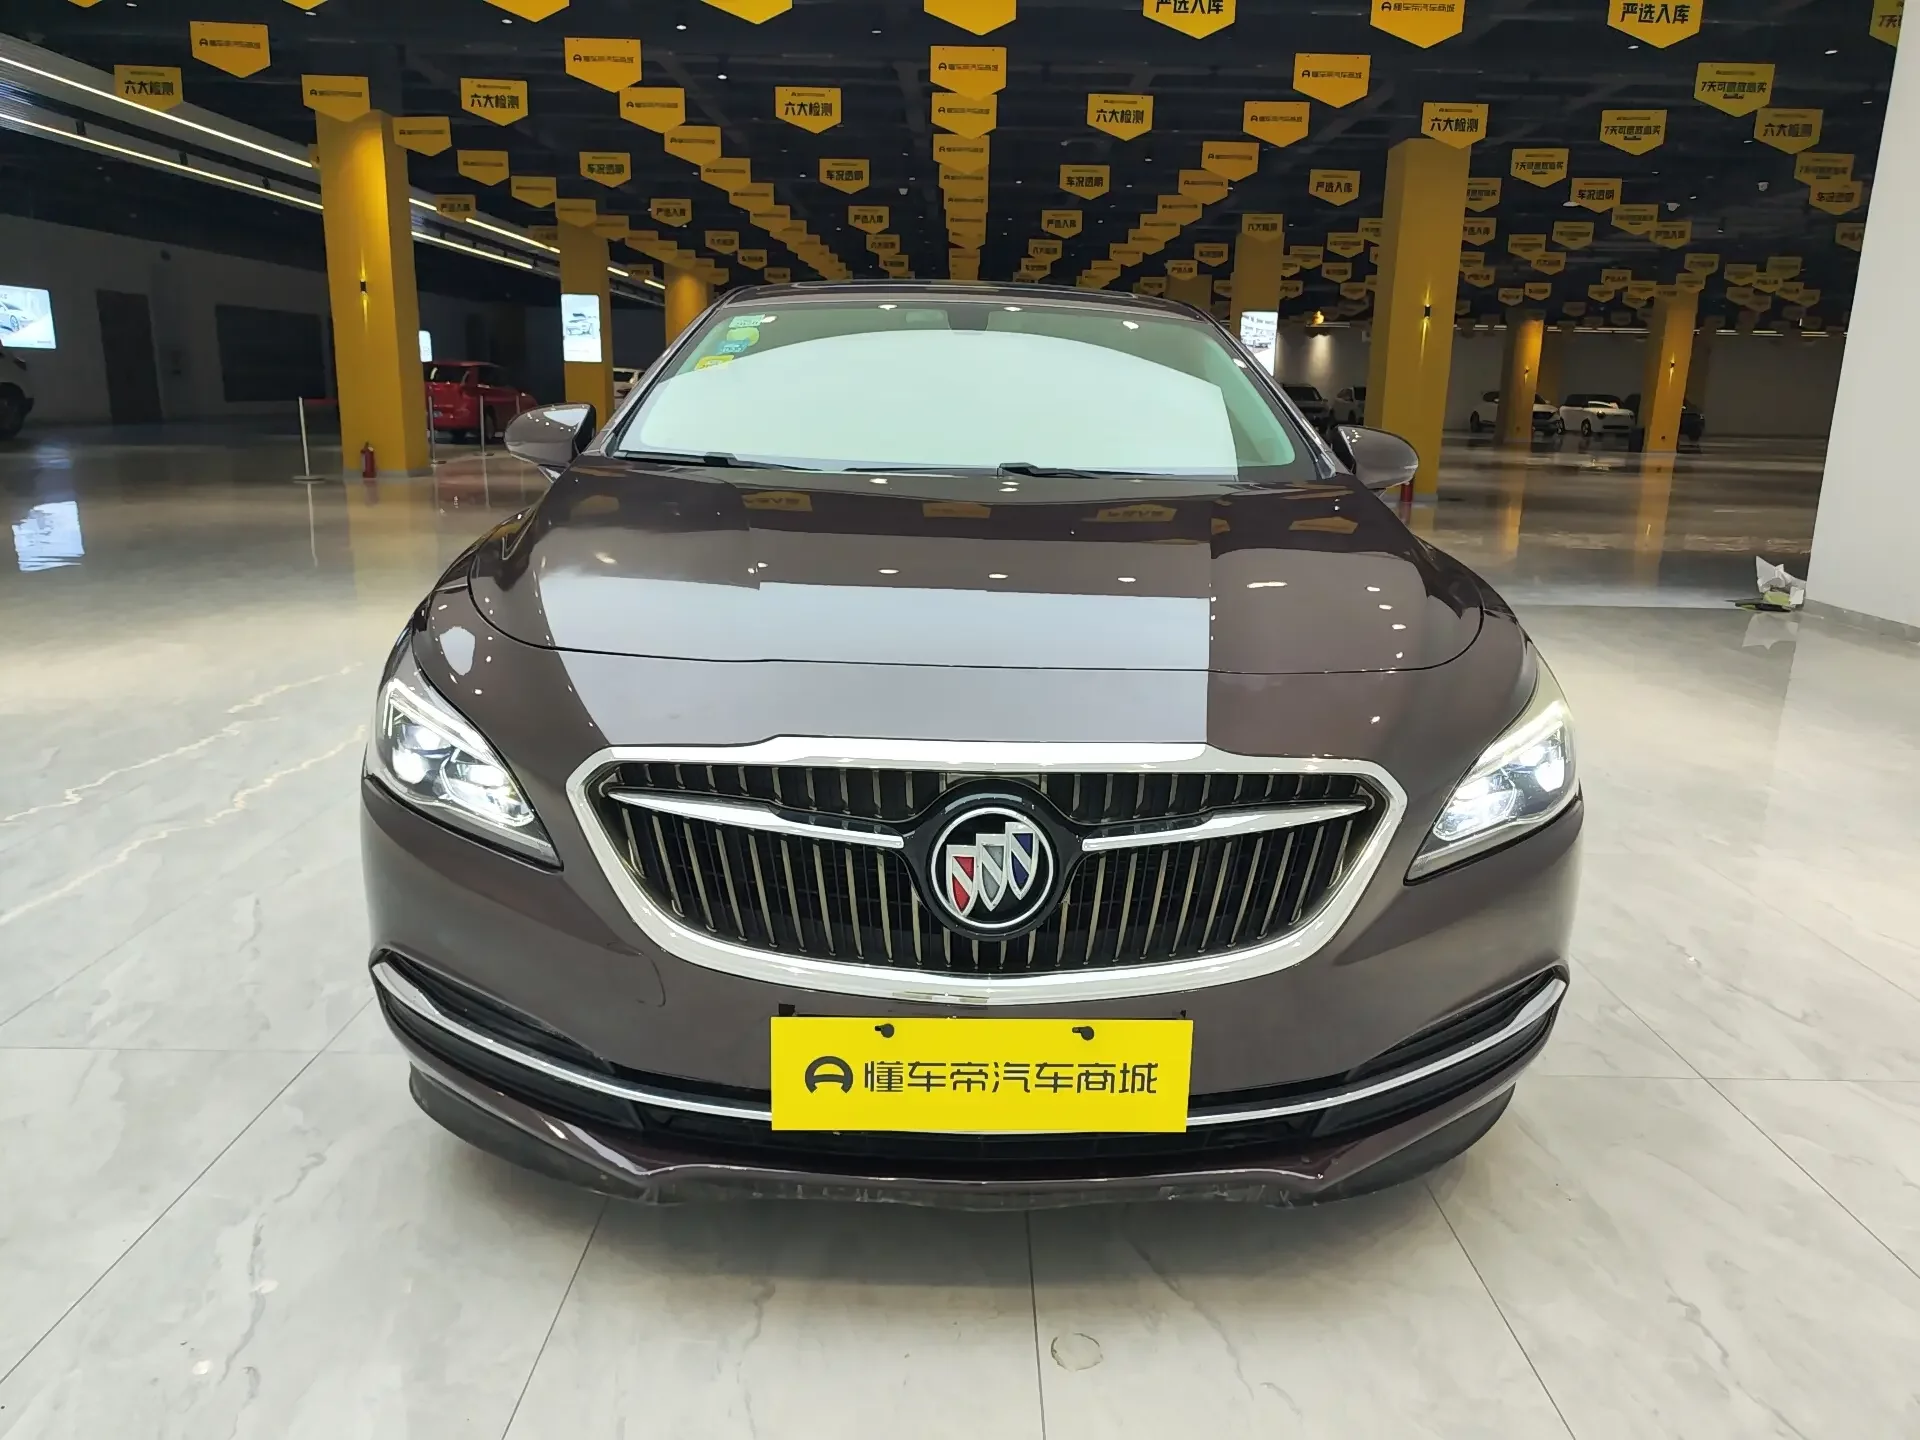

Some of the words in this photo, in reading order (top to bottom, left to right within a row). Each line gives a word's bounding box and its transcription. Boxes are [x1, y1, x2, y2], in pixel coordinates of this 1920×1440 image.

[1620, 3, 1690, 24] 严选入库
[785, 102, 832, 117] 六大检测
[1096, 109, 1144, 124] 六大检测
[1430, 118, 1478, 132] 六大检测
[864, 1060, 1158, 1094] 懂车帝汽车商城
